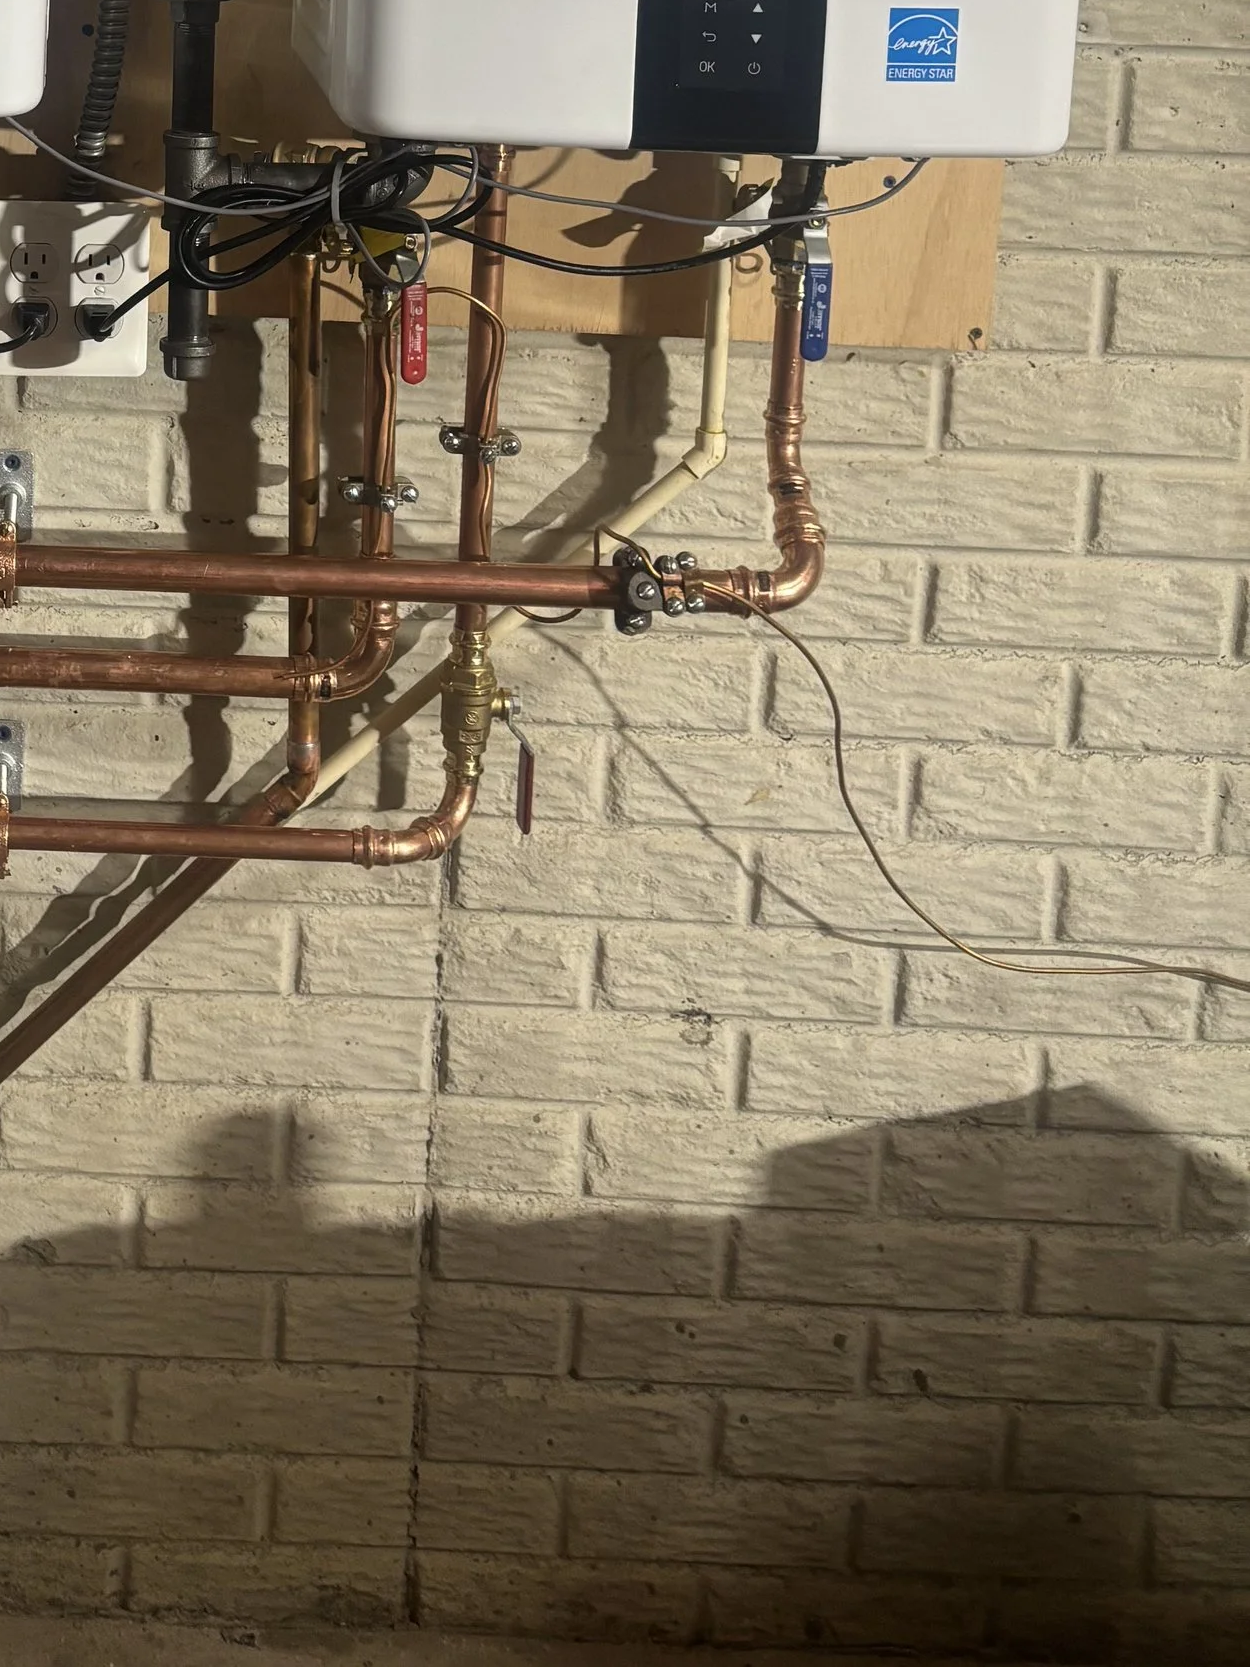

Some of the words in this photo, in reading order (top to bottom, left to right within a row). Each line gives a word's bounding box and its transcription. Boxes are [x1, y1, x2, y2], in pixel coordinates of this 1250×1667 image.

[704, 2, 717, 13] M
[889, 37, 940, 56] energy
[699, 60, 716, 73] OK
[888, 68, 927, 79] ENERGY
[928, 68, 954, 79] STAR
